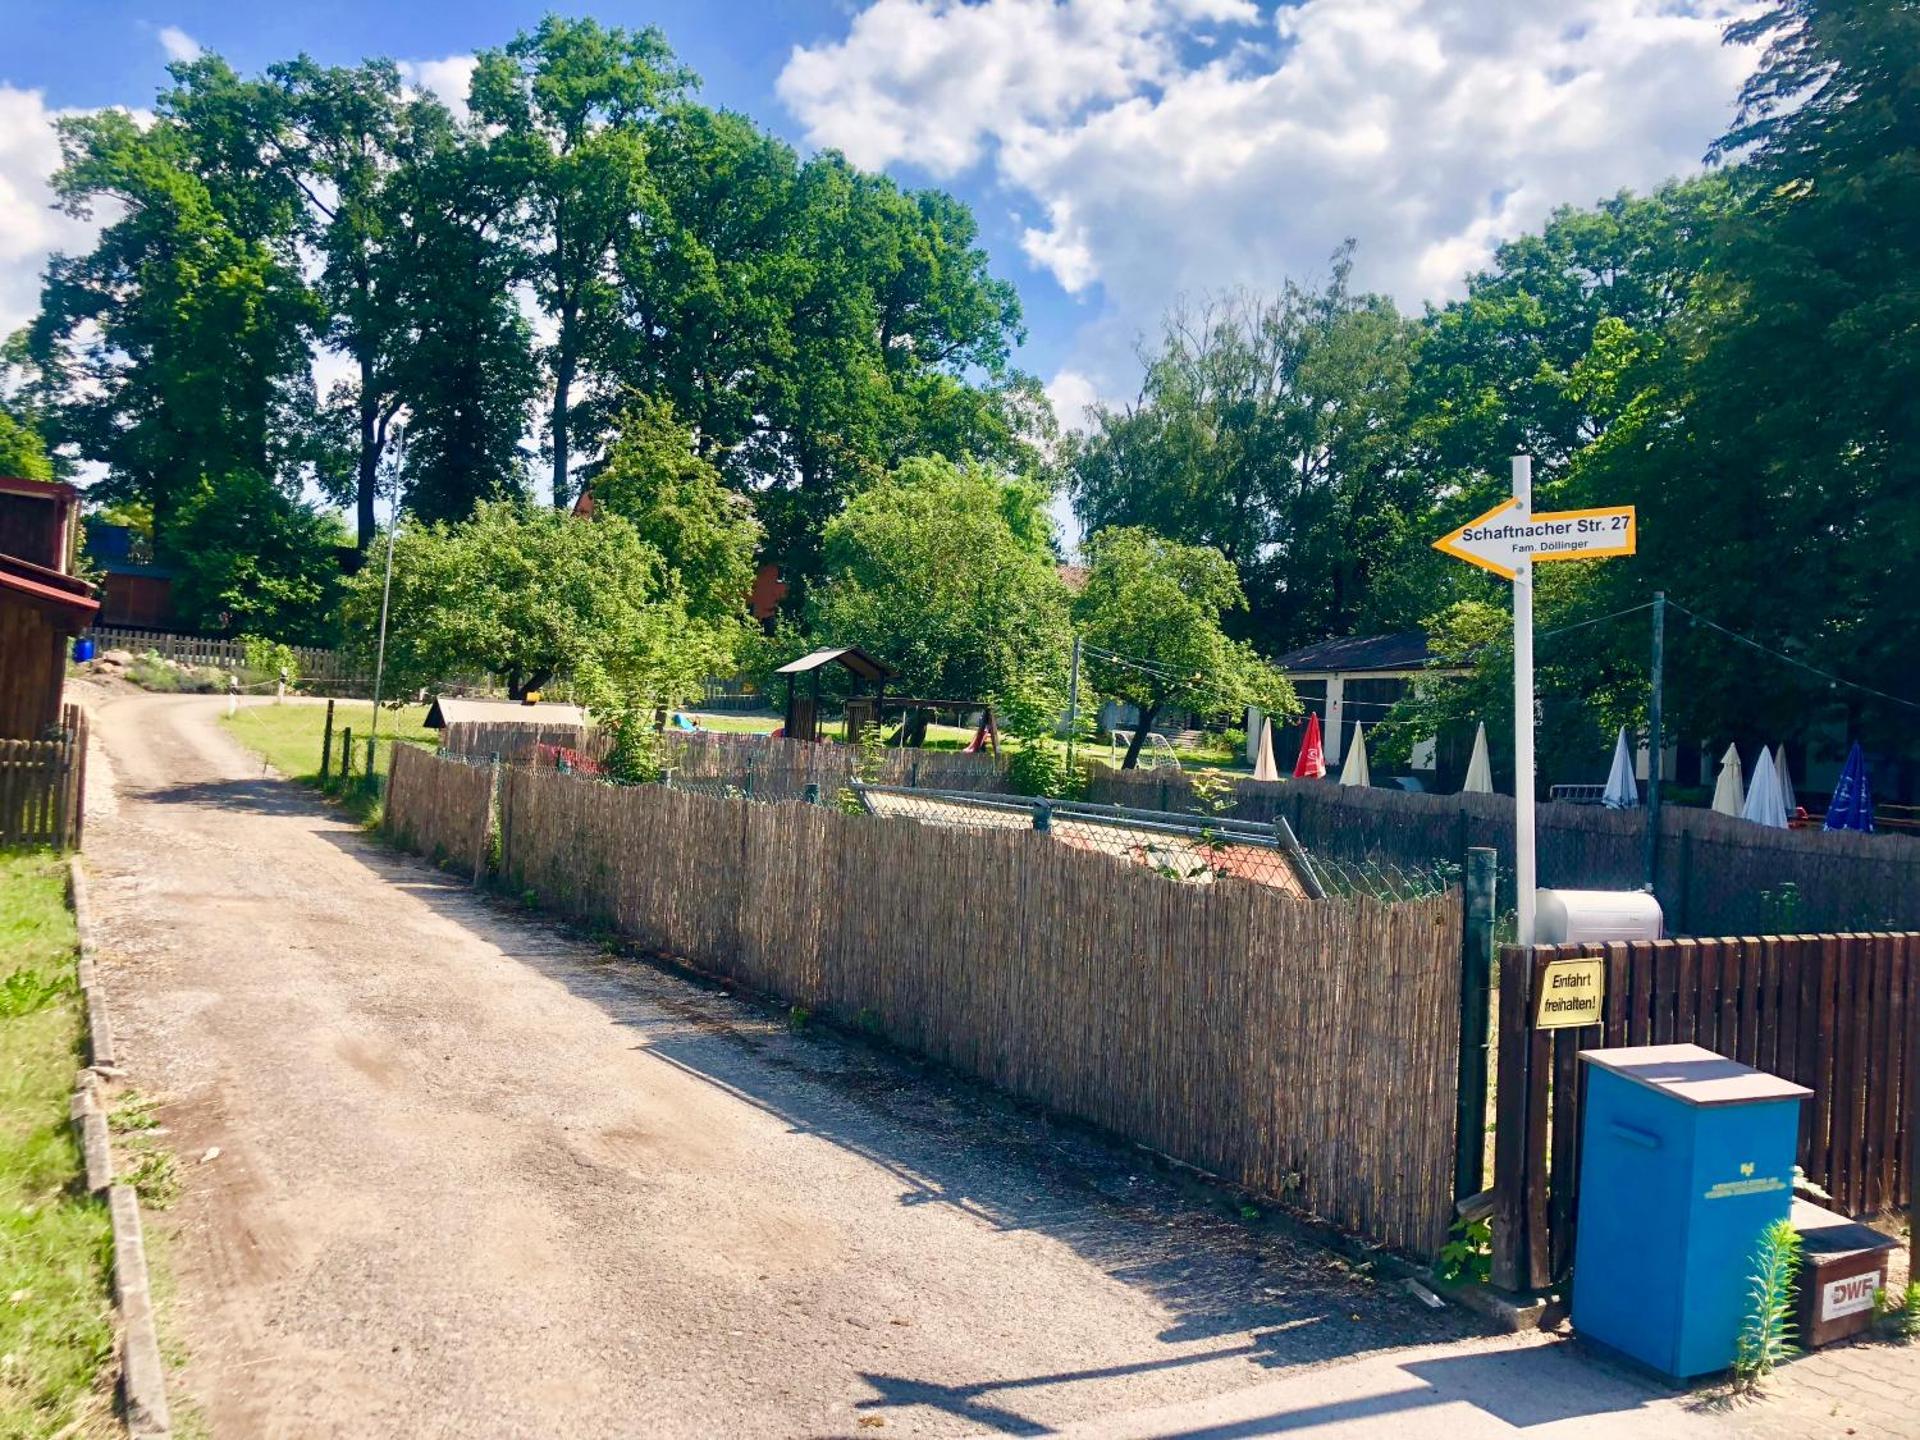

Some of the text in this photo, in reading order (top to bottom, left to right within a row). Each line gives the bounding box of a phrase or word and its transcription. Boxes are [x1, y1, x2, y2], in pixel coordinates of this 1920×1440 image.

[1462, 516, 1630, 542] Schaftnacher Str. 27
[1512, 543, 1537, 553] Fam.
[1552, 973, 1591, 988] Einfahrt
[1544, 995, 1596, 1012] freihalten!
